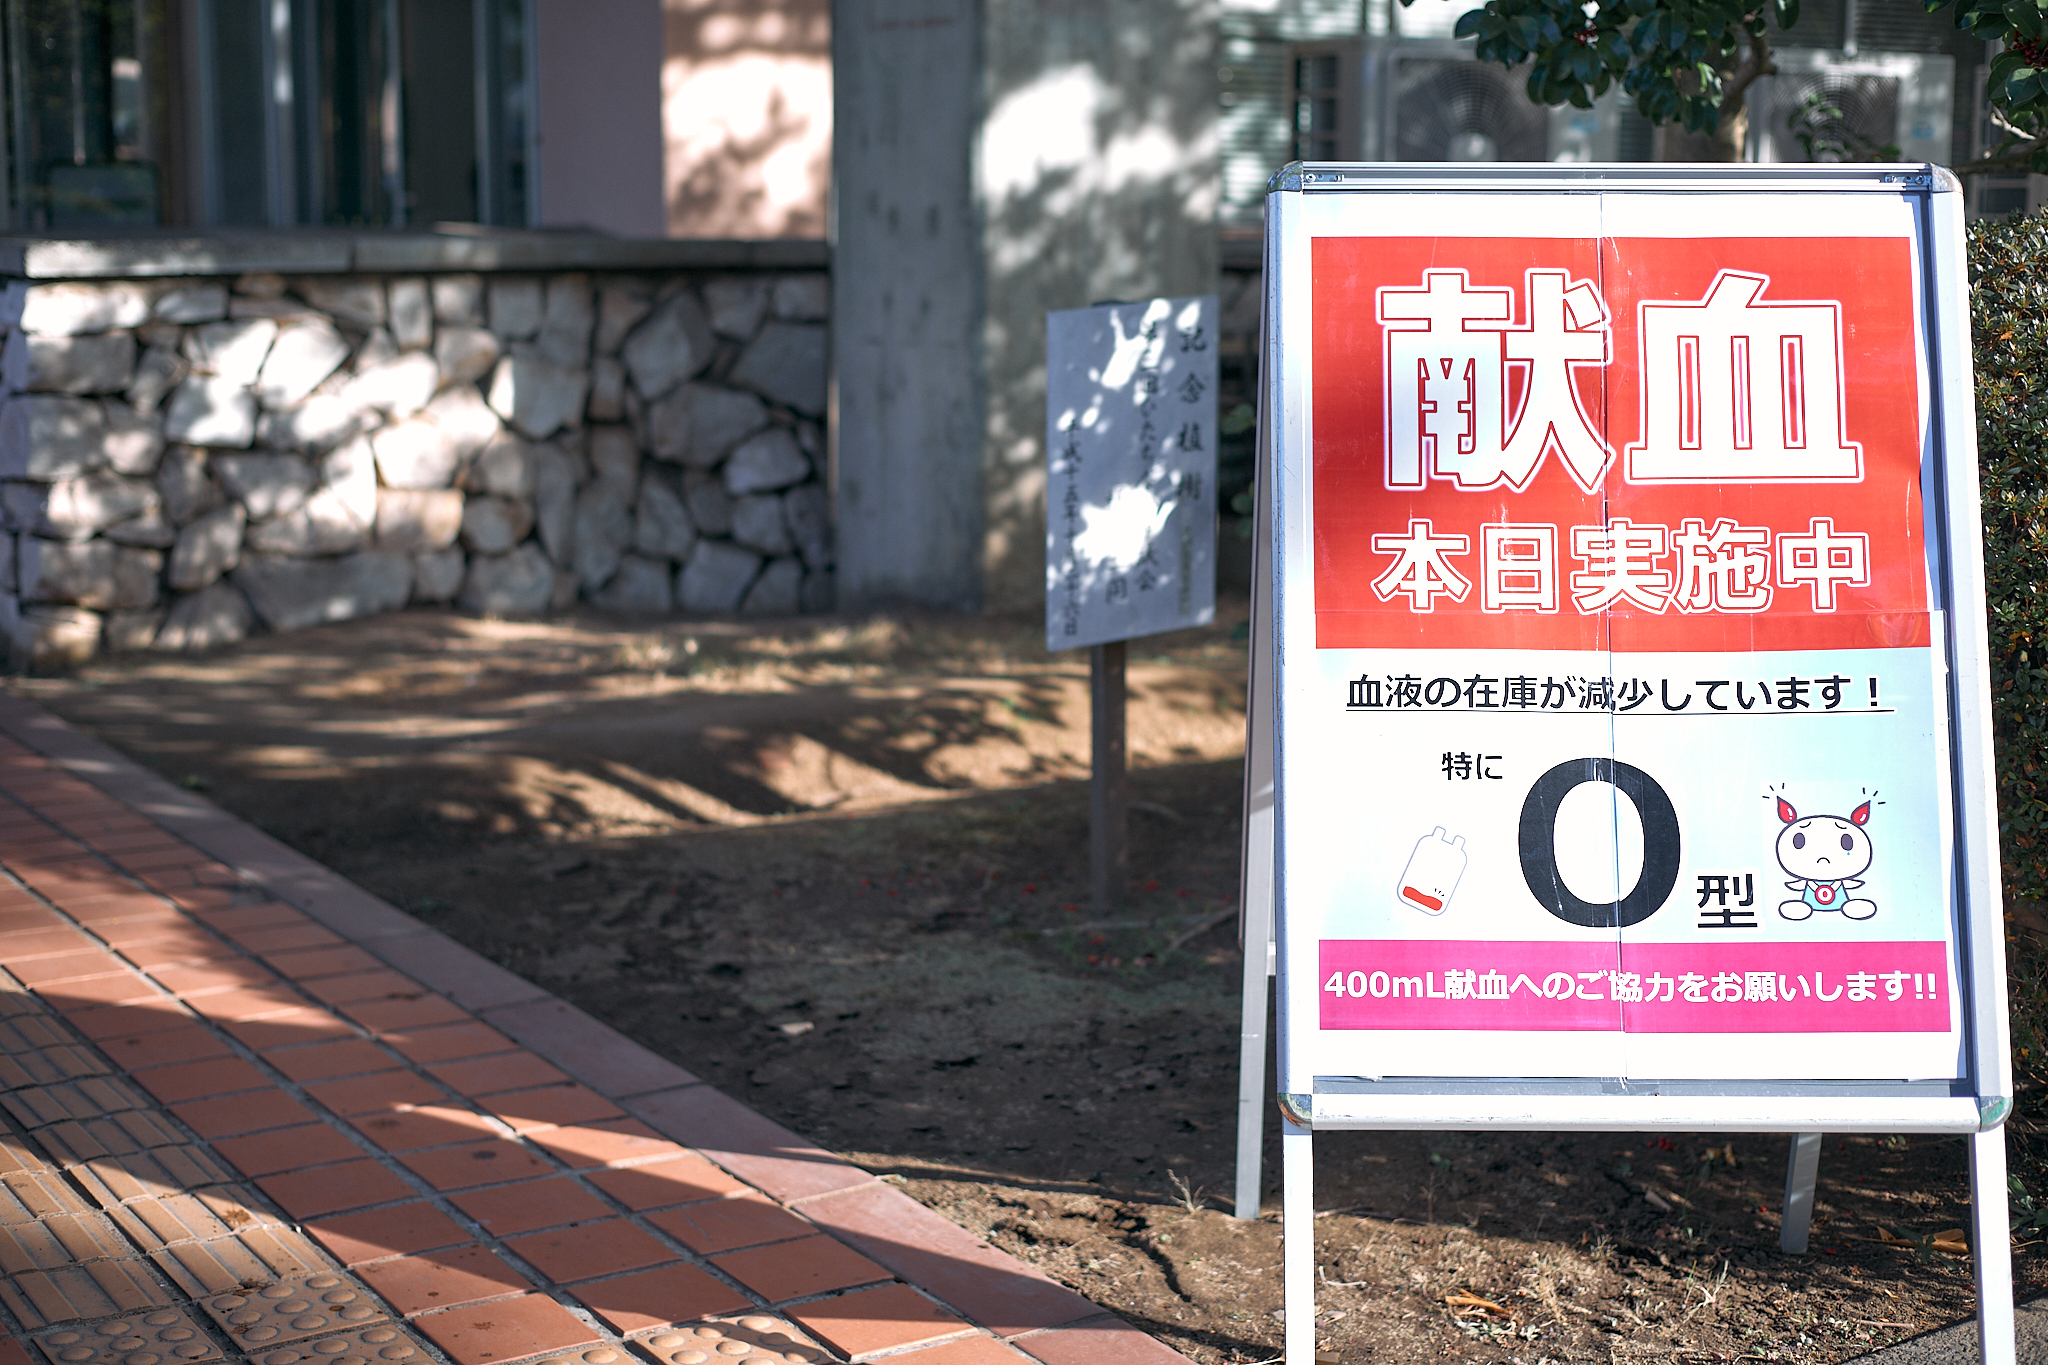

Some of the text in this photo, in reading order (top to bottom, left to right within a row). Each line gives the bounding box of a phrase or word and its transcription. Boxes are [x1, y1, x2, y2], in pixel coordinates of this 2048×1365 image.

[1374, 267, 1864, 494] 献血
[1370, 517, 1871, 615] 本日実施中
[1347, 673, 1882, 712] 血液の在庫が減少しています！
[1441, 751, 1504, 782] 特に
[1697, 873, 1758, 929] 型
